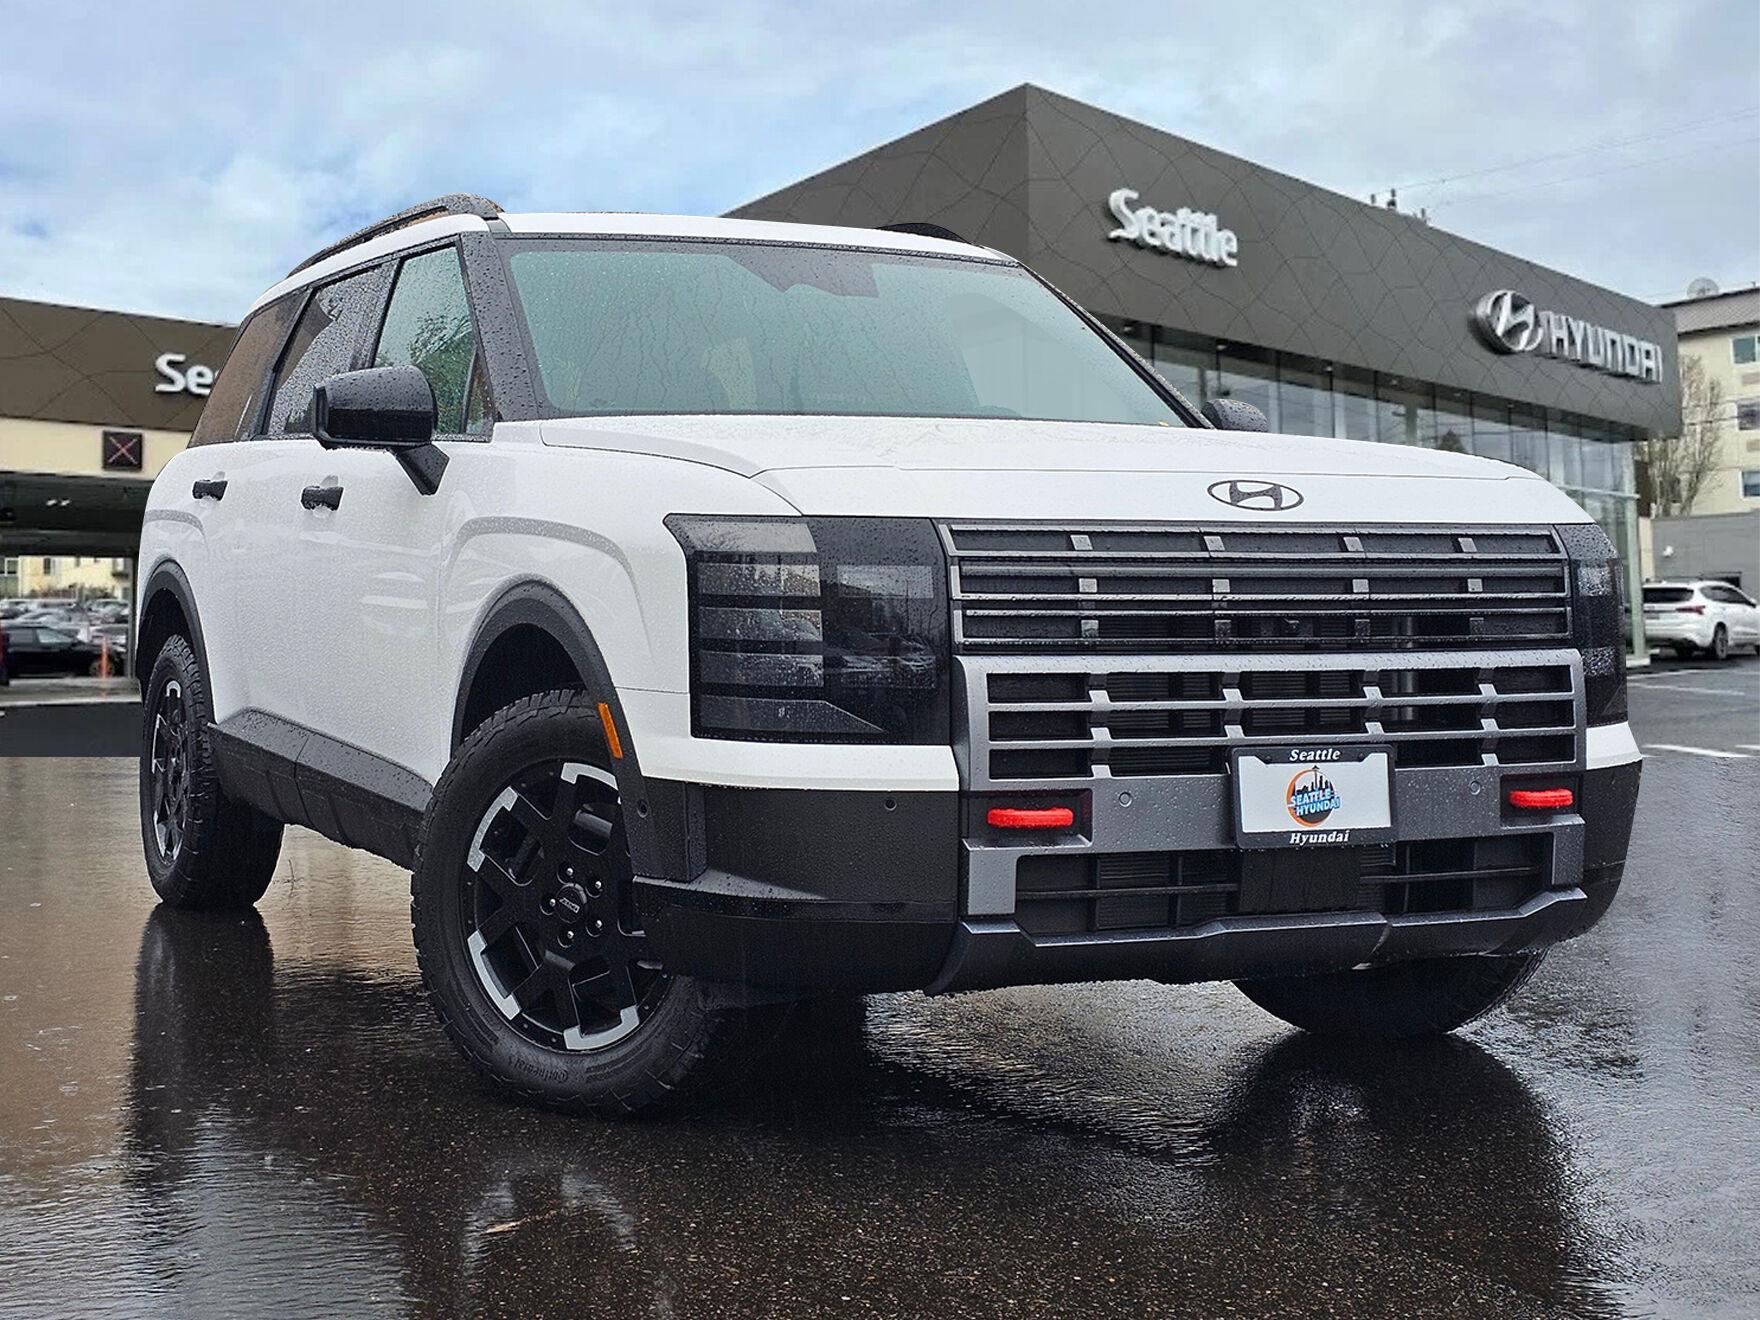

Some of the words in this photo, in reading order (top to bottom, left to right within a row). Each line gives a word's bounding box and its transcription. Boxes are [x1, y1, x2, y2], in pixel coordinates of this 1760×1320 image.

[1109, 188, 1238, 266] Seattle
[1539, 311, 1663, 383] HYUNDAI
[155, 352, 219, 396] Se
[1289, 749, 1341, 762] Seattle
[1290, 788, 1332, 806] SEATTLE
[1296, 794, 1341, 816] HYUNDAI
[1289, 830, 1351, 845] Hyundai
